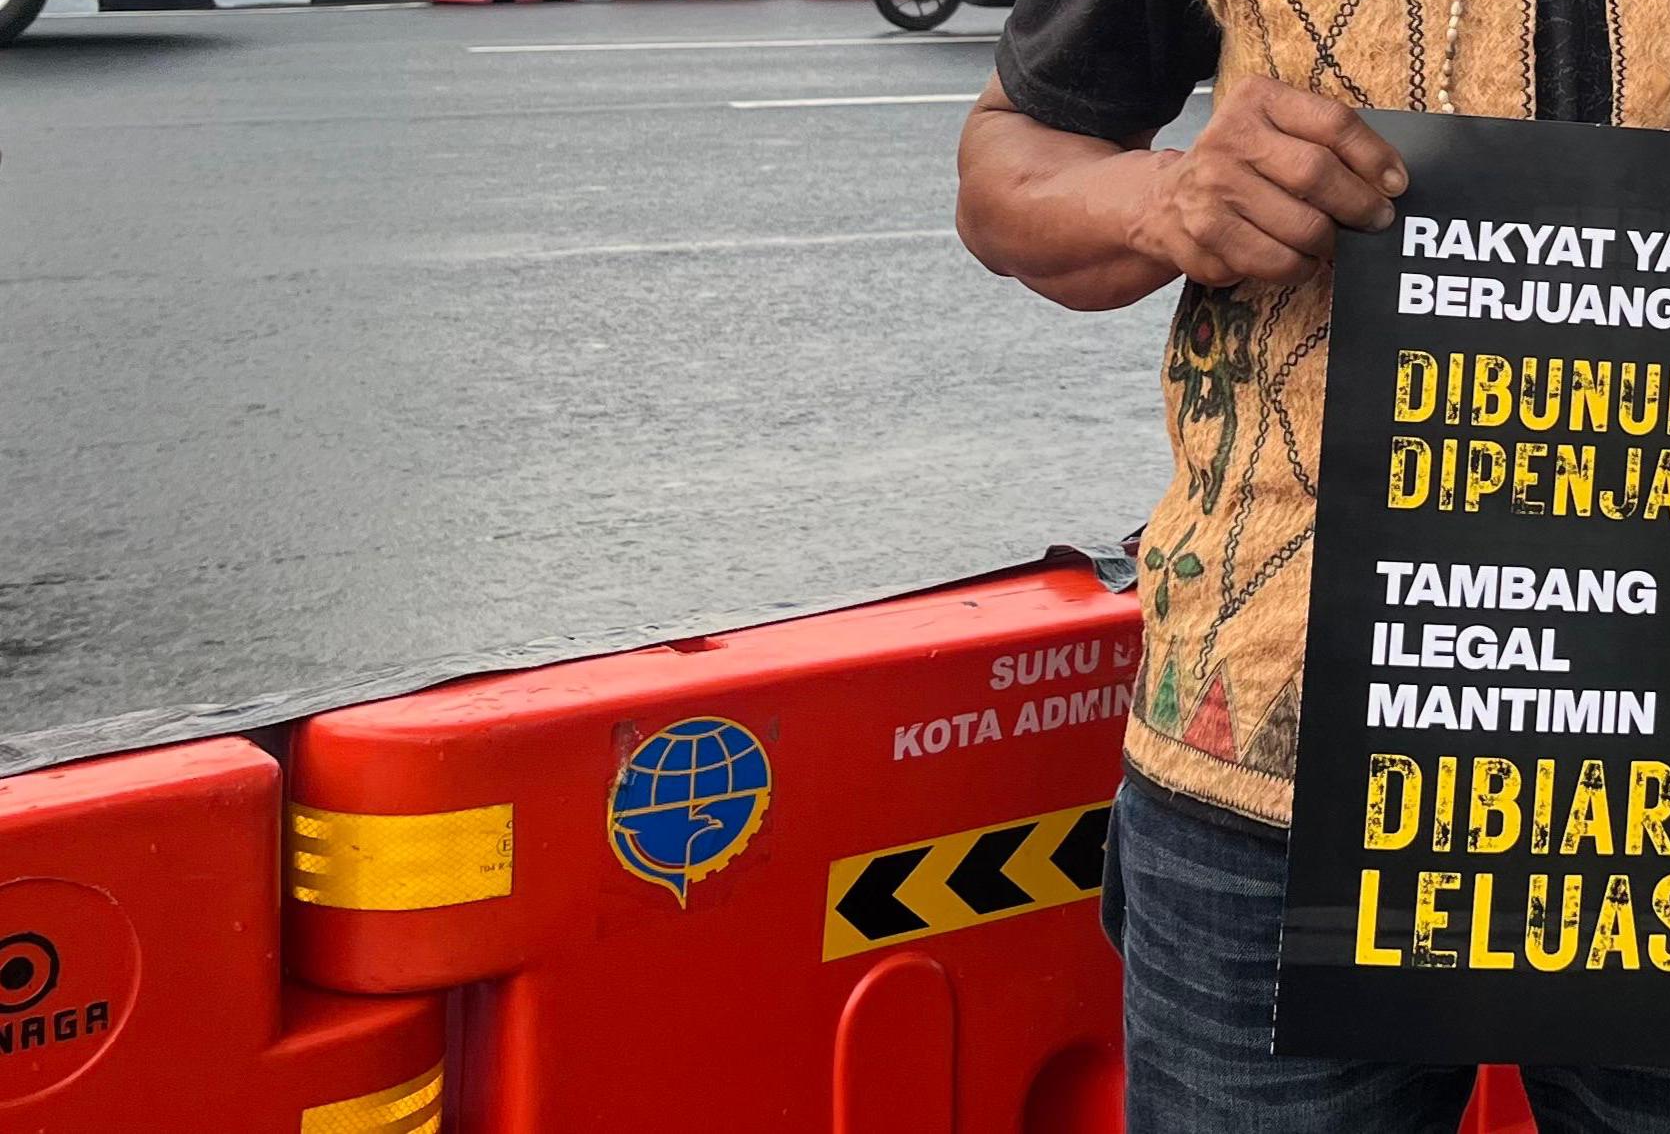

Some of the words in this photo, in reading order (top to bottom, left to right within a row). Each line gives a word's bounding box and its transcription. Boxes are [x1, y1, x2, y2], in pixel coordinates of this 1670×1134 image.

[1402, 216, 1616, 270] RAKYAT
[1376, 560, 1658, 615] TAMBANG
[989, 639, 1100, 691] SUKU
[1370, 621, 1571, 673] ILEGAL
[893, 709, 1003, 761] KOTA
[1013, 683, 1137, 737] ADMIN
[1366, 682, 1657, 735] MANTIMIN
